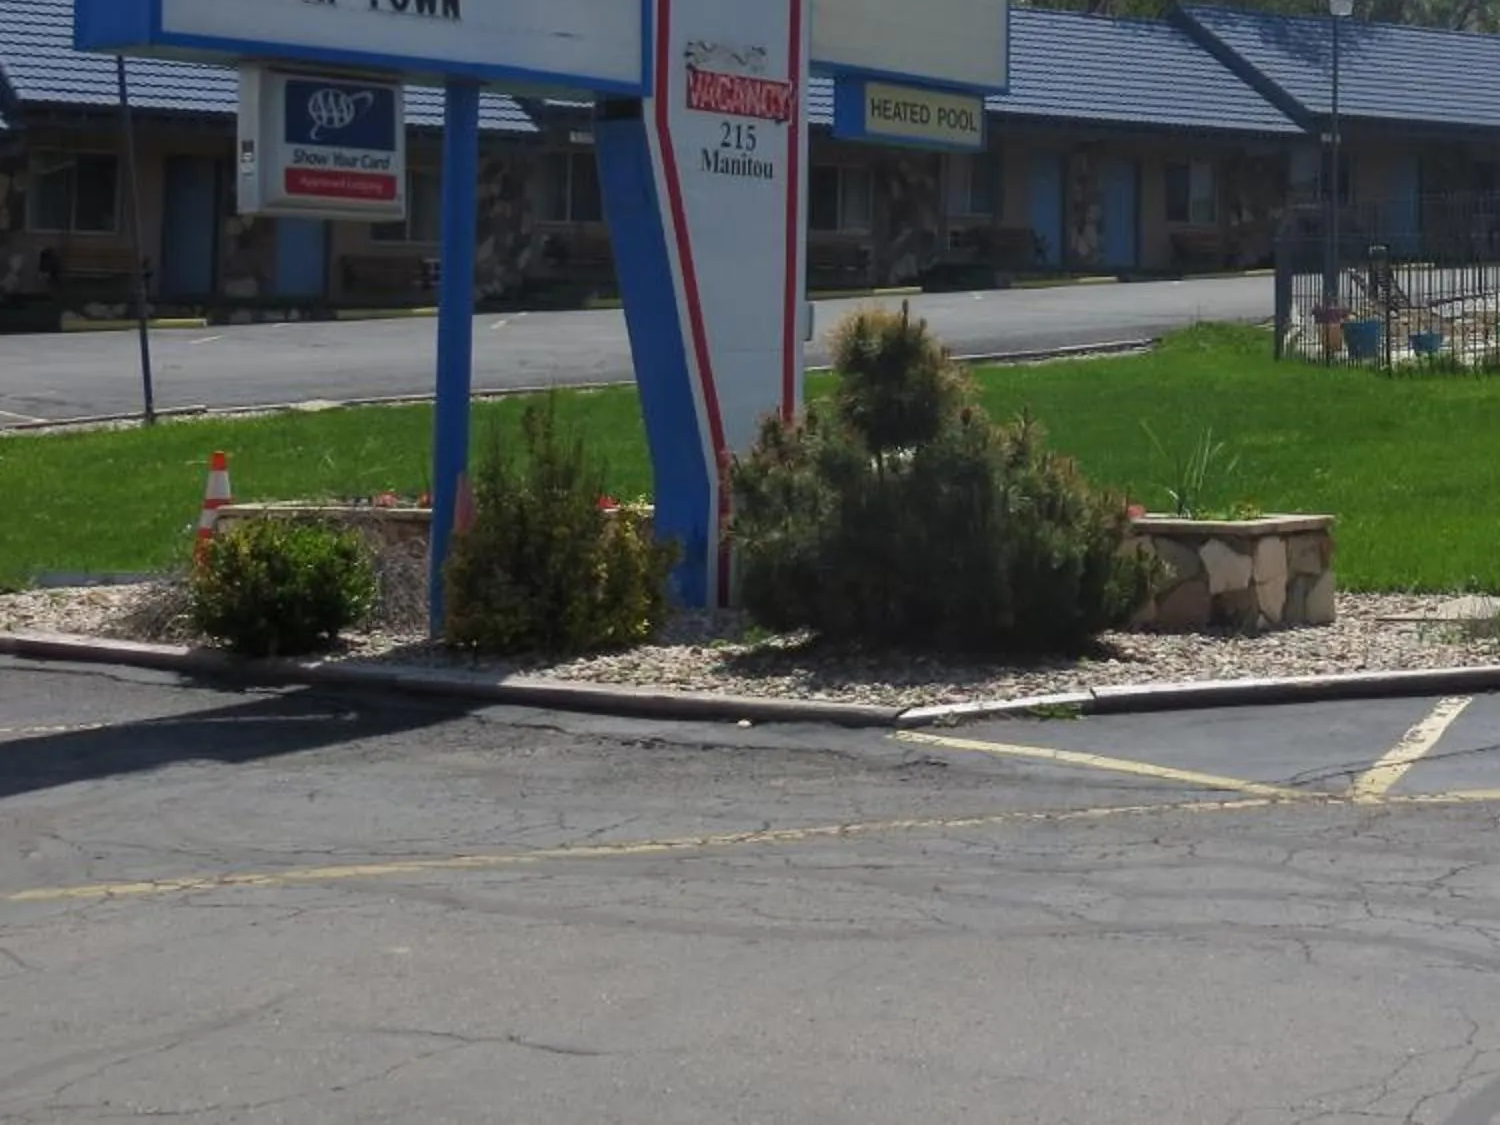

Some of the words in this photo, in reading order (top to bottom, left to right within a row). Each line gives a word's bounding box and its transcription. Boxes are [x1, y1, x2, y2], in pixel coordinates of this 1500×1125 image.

[688, 69, 793, 121] VACANCY
[870, 98, 931, 124] HEATED
[937, 106, 978, 133] POOL
[719, 120, 758, 151] 215
[292, 148, 328, 166] Show
[332, 151, 358, 167] Your
[360, 155, 391, 170] Card
[701, 147, 774, 180] Manitou
